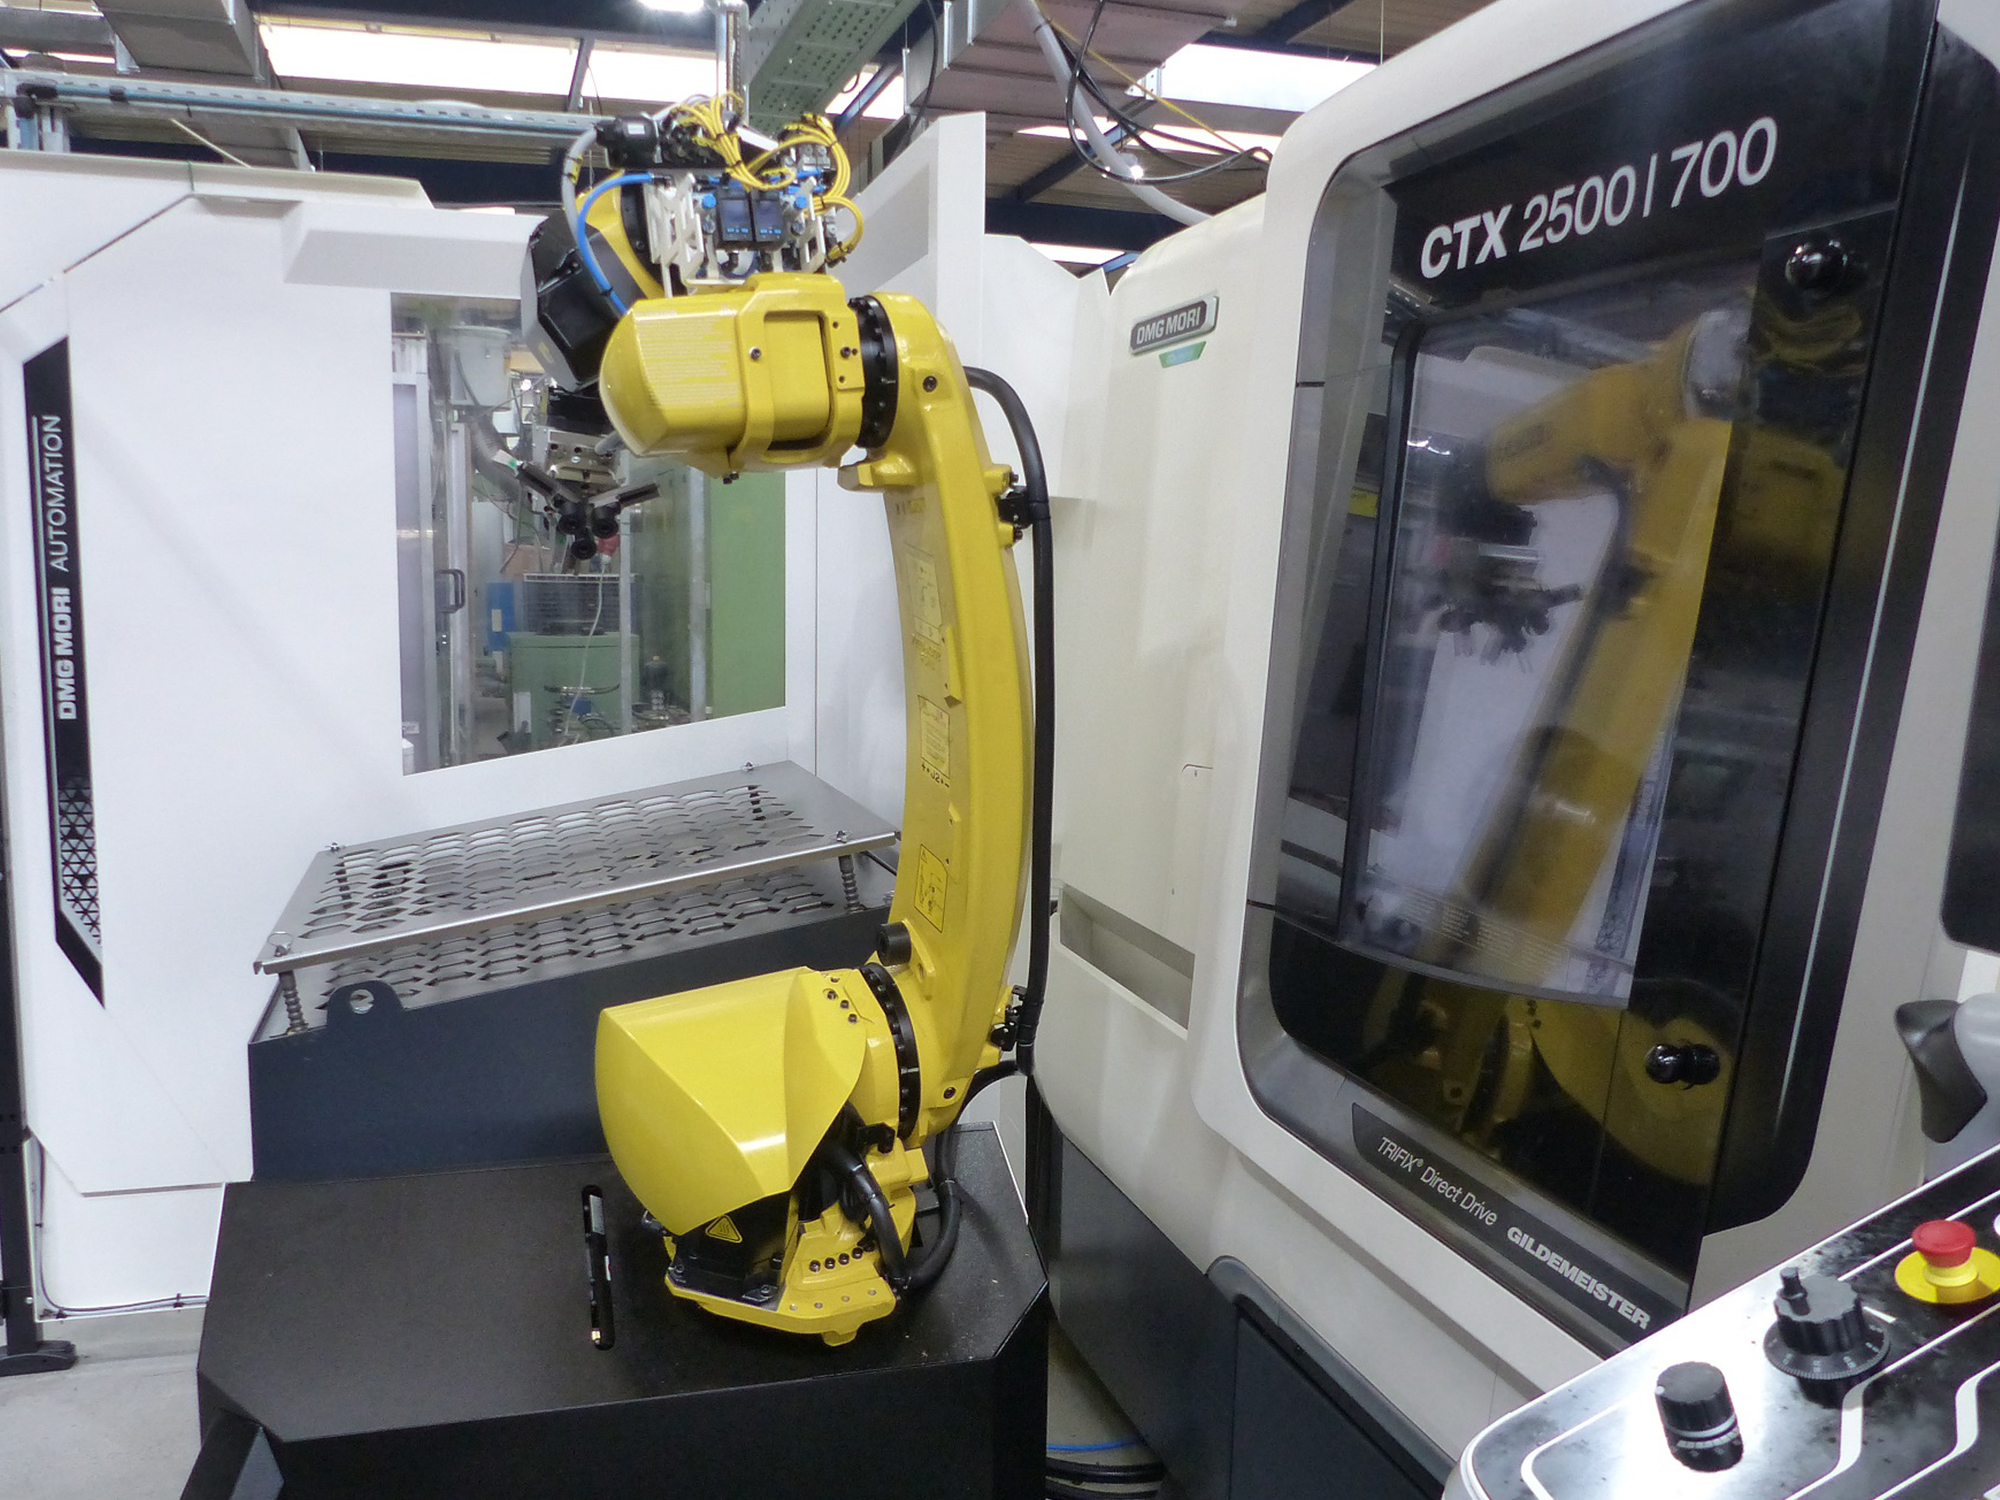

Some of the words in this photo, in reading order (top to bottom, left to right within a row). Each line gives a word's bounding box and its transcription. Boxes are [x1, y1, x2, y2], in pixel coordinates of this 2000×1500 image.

[1420, 204, 1513, 280] CTX
[1136, 319, 1165, 345] DMG
[1165, 306, 1201, 335] MORI
[42, 414, 69, 573] AUTOMATION
[51, 586, 74, 656] MORI
[54, 658, 78, 720] DMG
[1420, 1166, 1464, 1204] Direct
[1459, 1192, 1498, 1226] Drive
[1506, 1226, 1652, 1330] GILDEMEISTER
